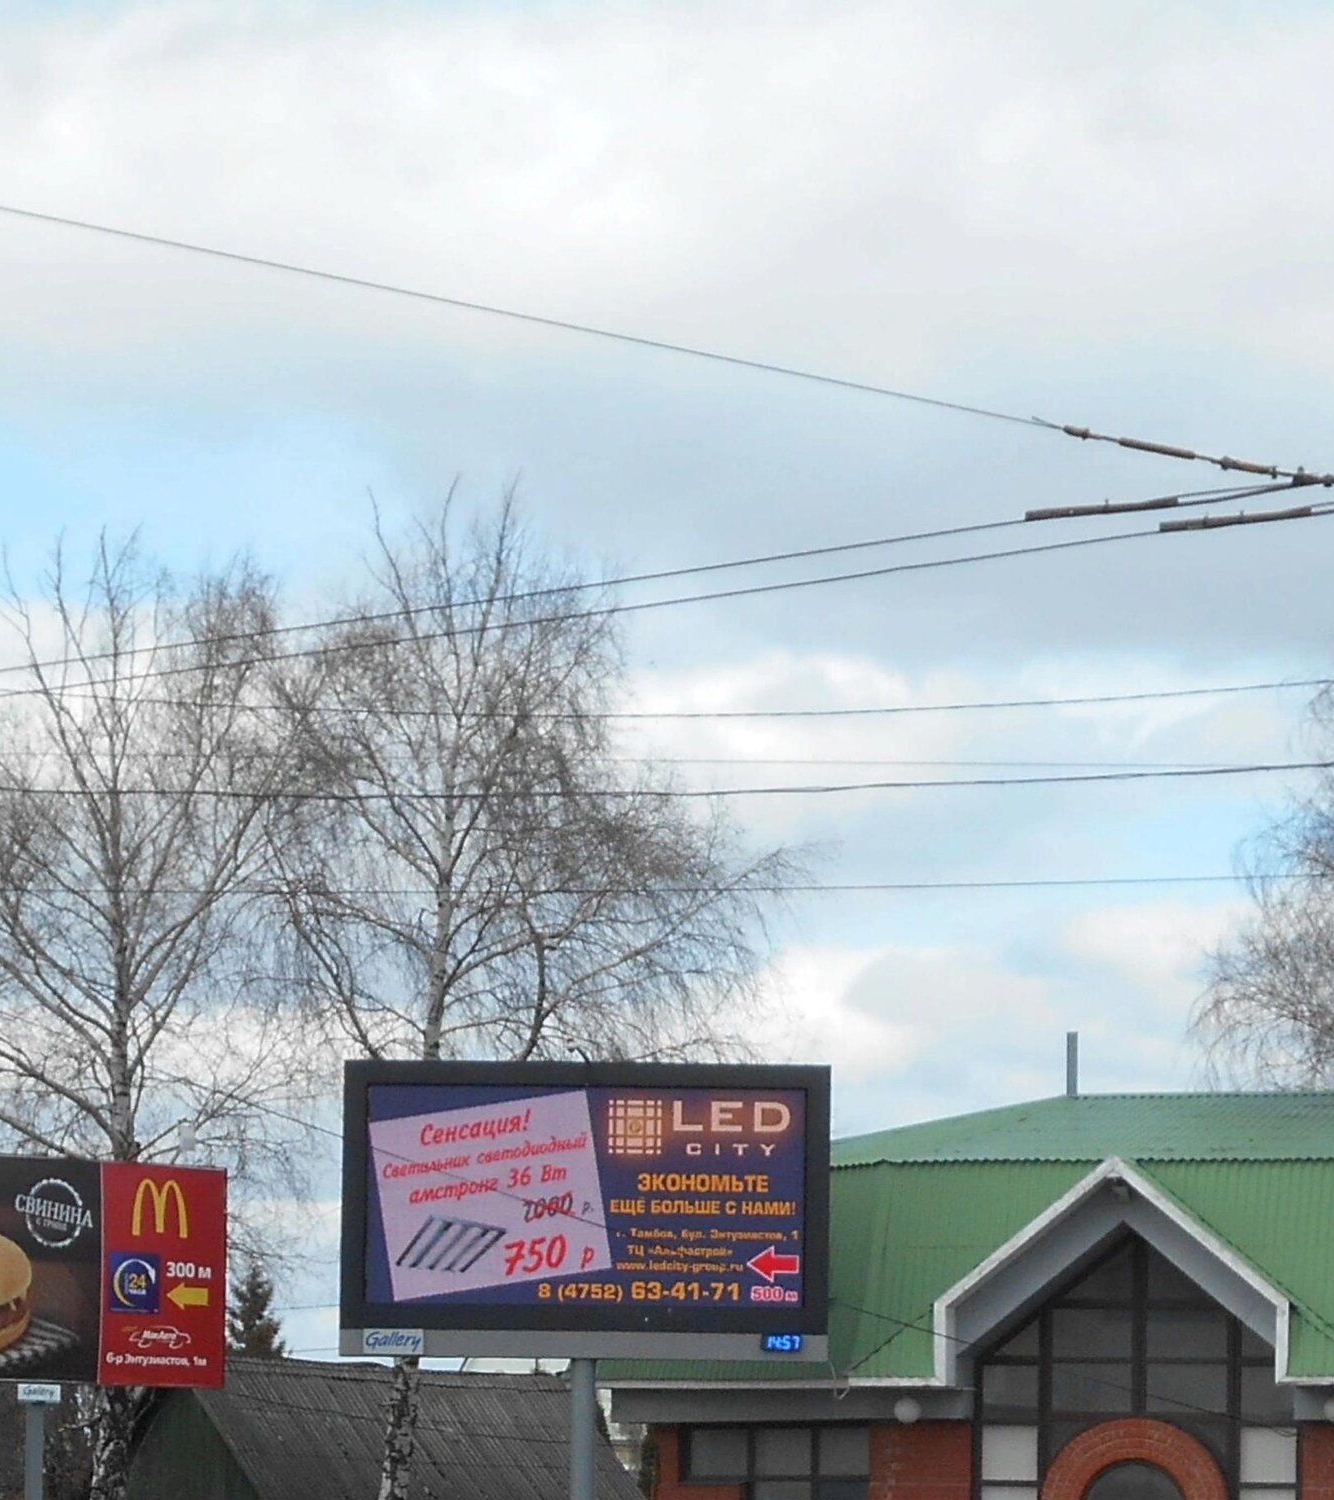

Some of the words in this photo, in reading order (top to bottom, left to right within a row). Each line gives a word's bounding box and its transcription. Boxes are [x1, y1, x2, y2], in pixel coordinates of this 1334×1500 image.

[673, 1100, 791, 1132] LED
[420, 1109, 531, 1146] Сенсация!
[383, 1155, 470, 1179] Светильник
[477, 1132, 588, 1165] светодиодный
[686, 1143, 776, 1156] CITY
[409, 1177, 498, 1204] амстронг
[507, 1166, 531, 1189] 36
[541, 1164, 567, 1182] Вт
[637, 1173, 769, 1193] ЭКОНОМЬТЕ
[15, 1194, 93, 1229] СВИНИНА
[650, 1200, 720, 1214] БОЛЬШЕ
[725, 1201, 737, 1215] С
[742, 1201, 796, 1215] НАМИ!
[504, 1233, 567, 1276] 750
[581, 1246, 595, 1269] р
[129, 1273, 147, 1288] 24
[166, 1261, 195, 1278] 300
[198, 1267, 212, 1279] м
[538, 1283, 551, 1298] 8
[557, 1282, 624, 1302] (4752)
[630, 1281, 741, 1301] 63-41-71
[751, 1286, 784, 1301] 500
[366, 1331, 422, 1353] Gallery
